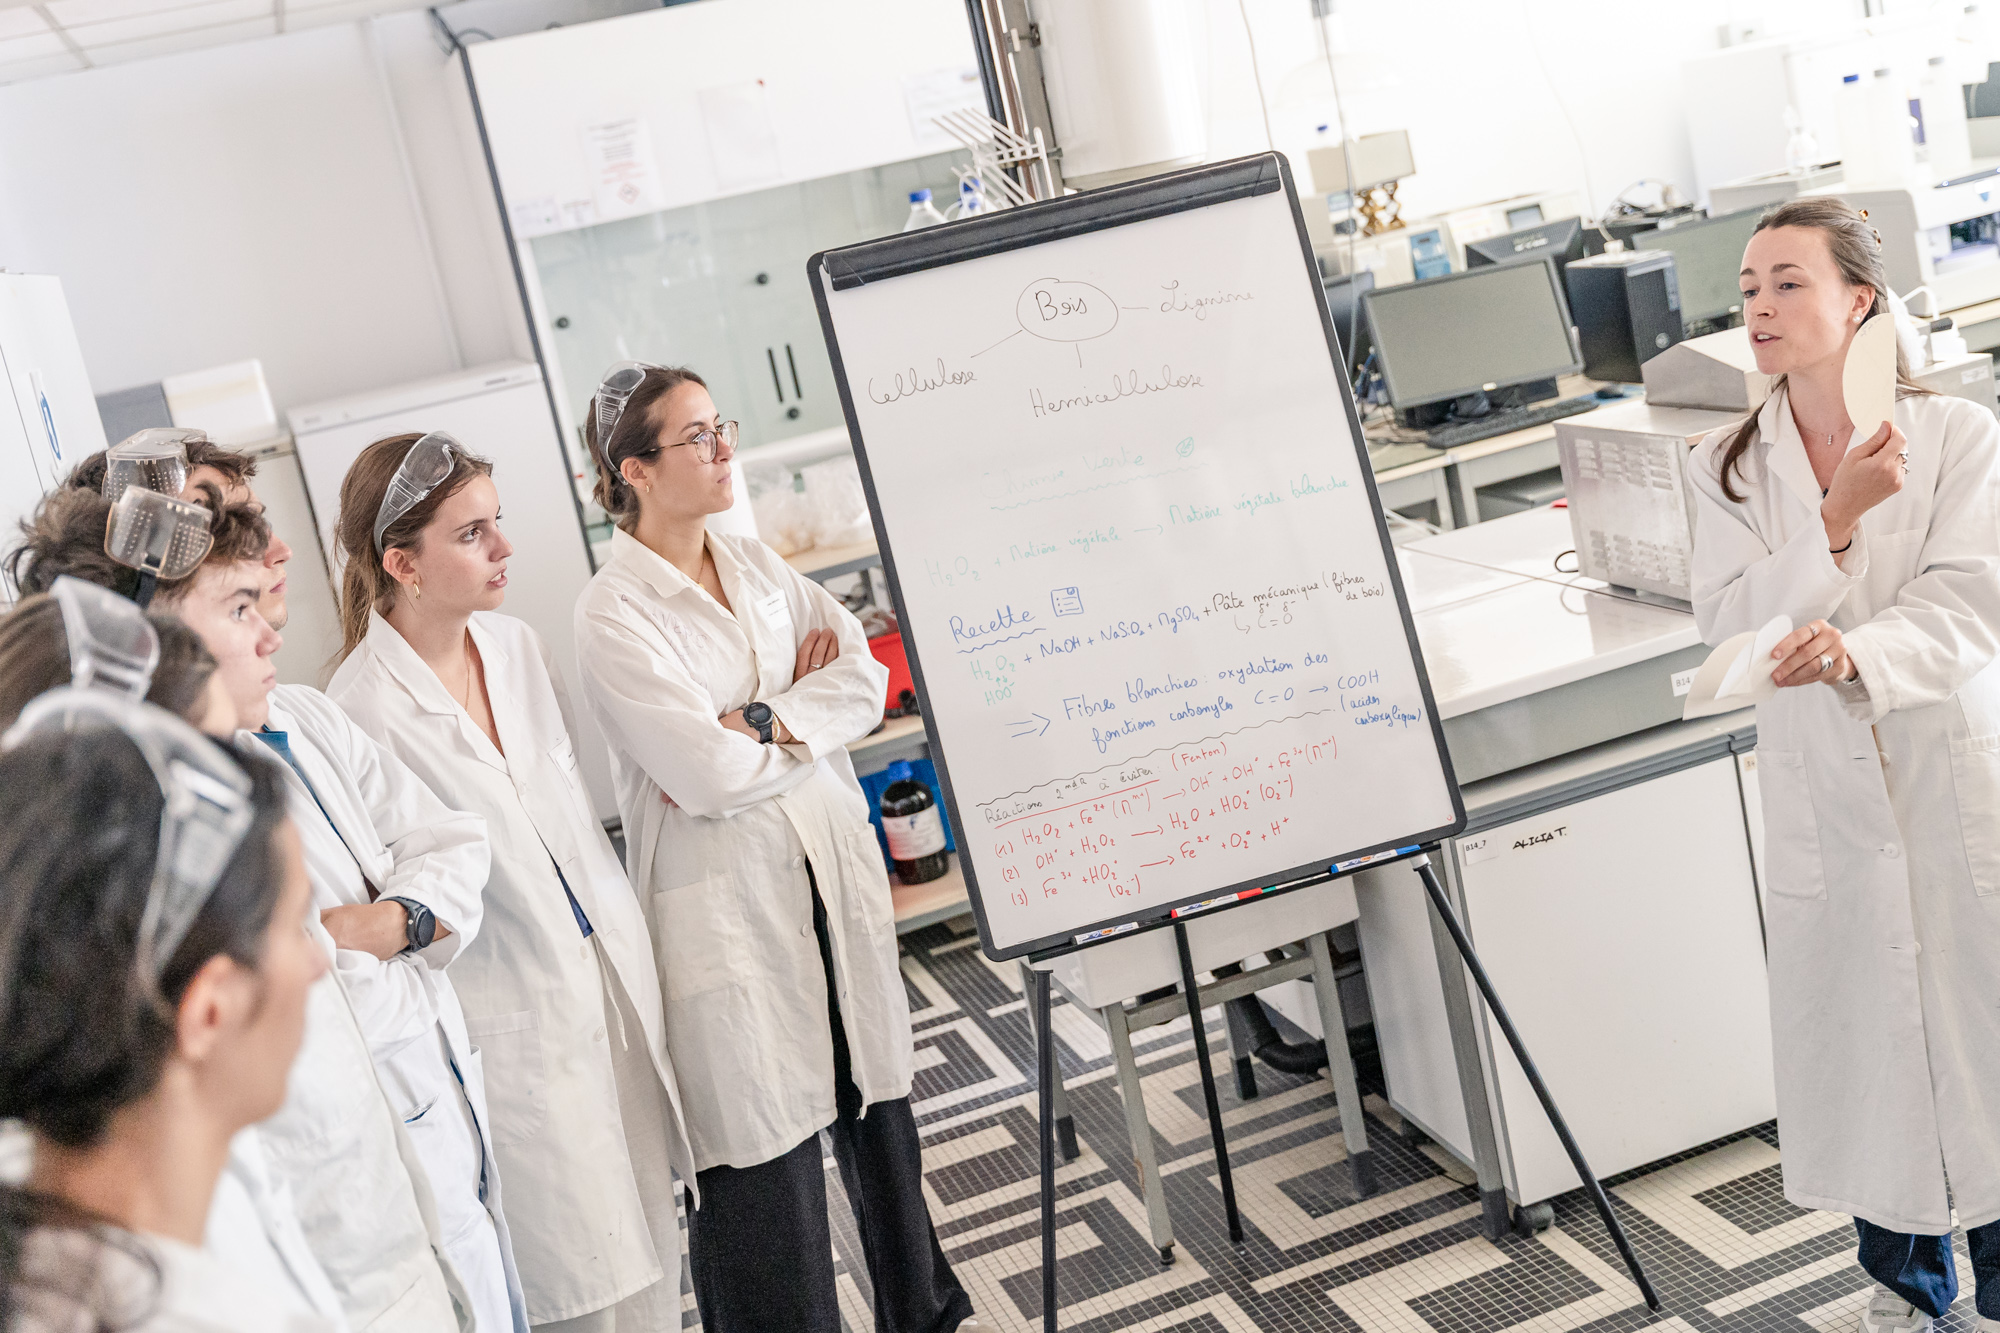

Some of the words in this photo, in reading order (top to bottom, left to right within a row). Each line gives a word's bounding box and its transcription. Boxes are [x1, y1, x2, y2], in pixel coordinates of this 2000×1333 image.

[1034, 290, 1087, 322] Bois
[1160, 280, 1254, 320] Lignine
[868, 358, 977, 405] Cellulose
[1345, 590, 1358, 601] de
[949, 605, 1036, 644] Recette
[1040, 635, 1081, 658] NaOH
[1212, 591, 1245, 612] Pâte
[1253, 582, 1319, 601] mécanique
[1063, 694, 1115, 720] Fibres
[1218, 656, 1293, 685] oxydation
[1304, 652, 1328, 667] des
[1092, 717, 1155, 753] fonctions
[1170, 696, 1233, 721] carbonyles
[1337, 669, 1379, 690] COOH
[1171, 741, 1227, 771] (Fenton)
[984, 800, 1042, 824] Réactions
[1512, 832, 1554, 850] ALICIA
